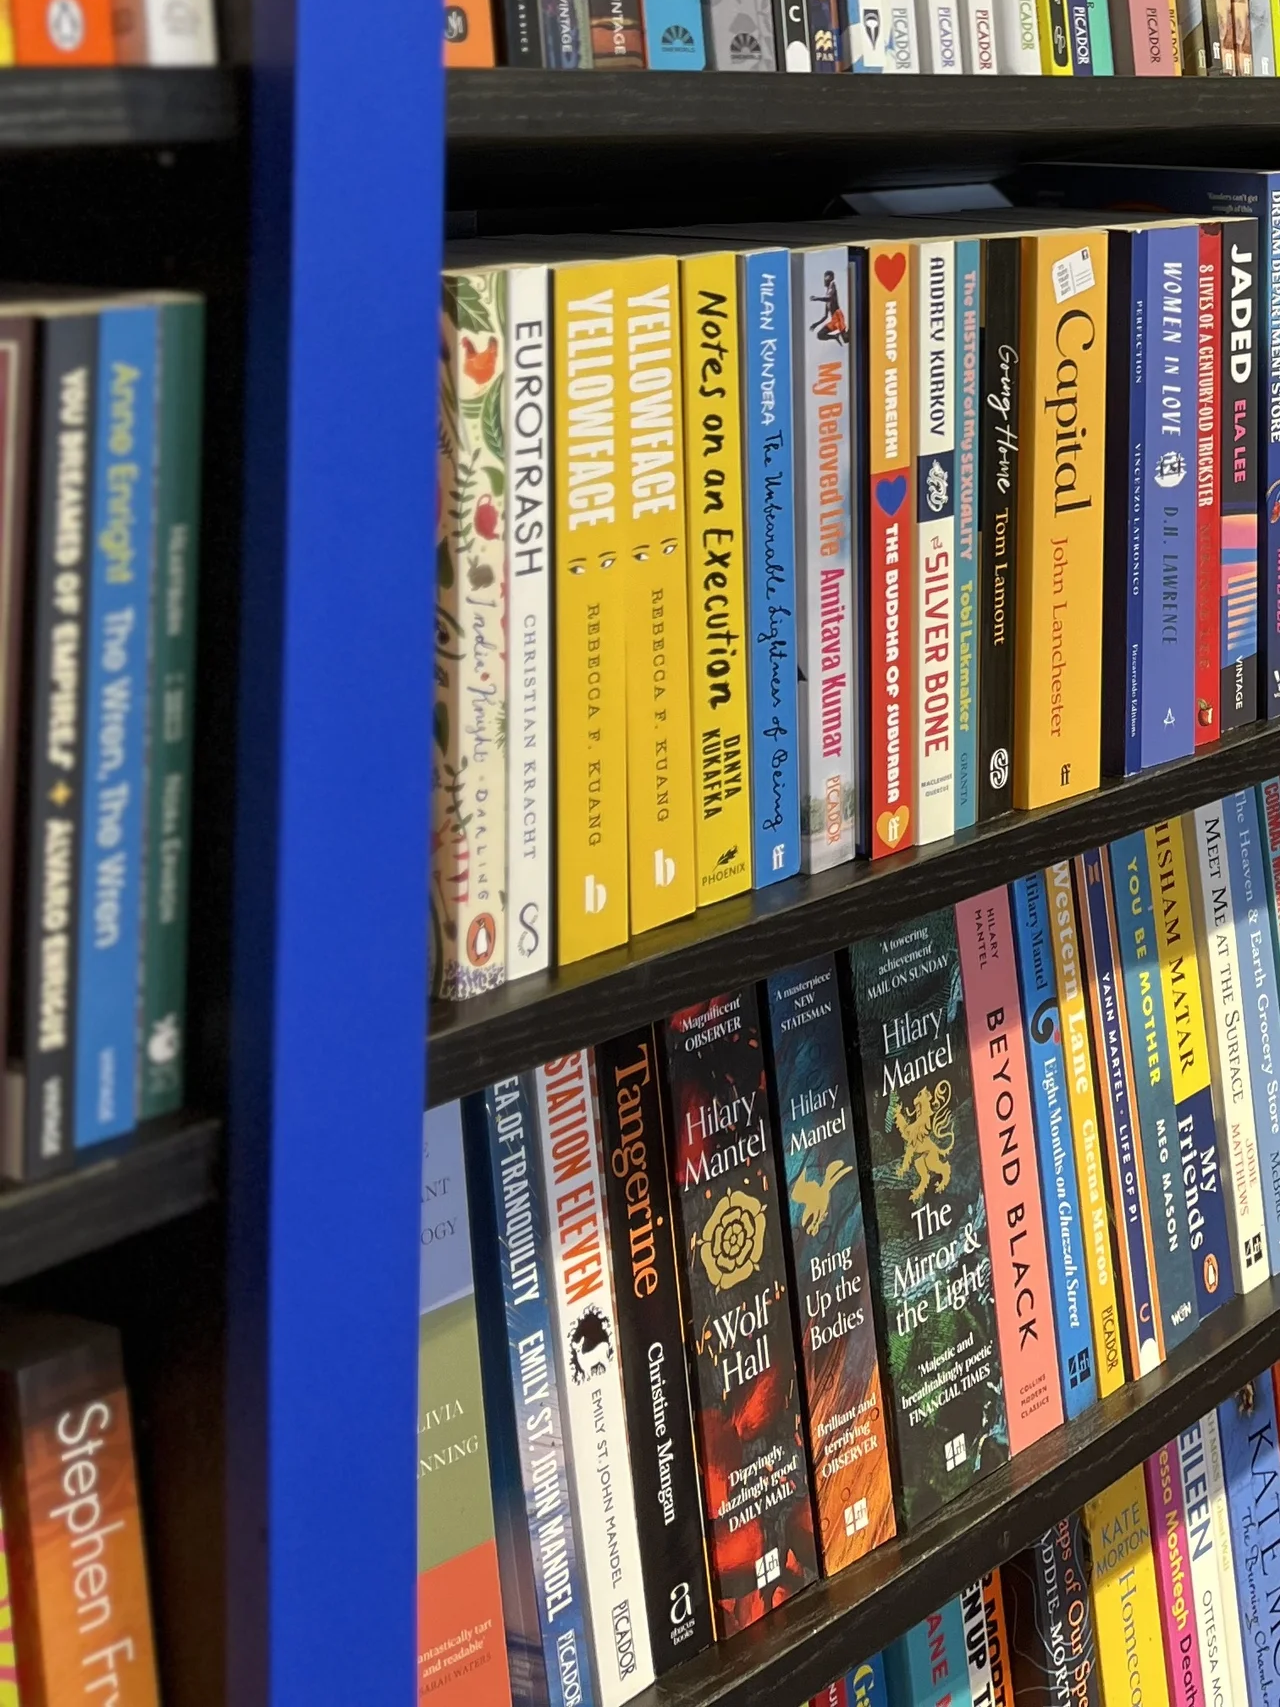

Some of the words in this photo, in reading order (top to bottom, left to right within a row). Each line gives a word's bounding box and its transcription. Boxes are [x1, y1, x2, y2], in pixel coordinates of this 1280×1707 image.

[1073, 6, 1088, 64] PICADOR
[760, 272, 775, 331] MILAN
[1162, 261, 1183, 344] WOMEN
[1230, 243, 1253, 384] JADED
[697, 290, 729, 399] Notes
[760, 338, 777, 426] KUNDERA
[1164, 356, 1180, 376] IN
[110, 364, 140, 452] Anne
[568, 289, 614, 531] YELLOWFACE
[627, 284, 676, 519] YELLOWFACE
[929, 350, 945, 437] KURKOV
[1044, 309, 1096, 518] Capital
[1161, 384, 1182, 437] LOVE
[1233, 400, 1247, 442] ELA
[514, 321, 543, 578] EUROTRASH
[703, 414, 726, 457] on
[1234, 445, 1247, 484] LEE
[703, 469, 726, 514] an
[885, 523, 899, 565] THE
[1050, 537, 1070, 595] John
[703, 528, 741, 710] Execution
[885, 568, 899, 662] BUDDHA
[925, 552, 948, 664] SILVER
[523, 614, 537, 749] CHRISTIAN
[886, 665, 900, 698] OF
[1050, 601, 1067, 738] Lanchester
[886, 703, 900, 803] SUBURBIA
[925, 671, 948, 756] BONE
[702, 728, 722, 821] KUKAFKA
[723, 735, 743, 801] DANYA
[523, 760, 537, 859] KRACHT
[702, 862, 746, 885] PHOENIX
[1126, 856, 1141, 915] YOU
[1135, 927, 1147, 959] BE
[882, 1008, 943, 1056] Hilary
[1138, 972, 1161, 1087] MOTHER
[1168, 956, 1195, 1076] MATAR
[882, 1033, 953, 1097] Mantel
[683, 1119, 767, 1191] Mantel
[685, 1091, 757, 1146] Hilary
[613, 1043, 664, 1299] Tangerine
[986, 1007, 1020, 1185] BEYOND
[1007, 1202, 1038, 1352] BLACK
[1178, 1114, 1205, 1251] Friends
[1199, 1145, 1217, 1195] My
[500, 1146, 539, 1305] TRANQUILITY
[556, 1180, 603, 1305] ELEVEN
[894, 1239, 960, 1300] Mirror
[962, 1222, 982, 1254] &
[911, 1203, 952, 1243] The
[806, 1289, 832, 1318] Up
[834, 1269, 862, 1304] the
[810, 1247, 853, 1282] Bring
[896, 1299, 929, 1338] the
[933, 1264, 986, 1314] Light
[714, 1288, 771, 1350] Wolf
[811, 1309, 865, 1351] Bodies
[519, 1330, 549, 1409] EMILY
[647, 1343, 670, 1438] Christine
[723, 1335, 772, 1394] Hall
[50, 1400, 125, 1634] Stephen
[531, 1450, 559, 1518] JOHN
[657, 1439, 674, 1525] Mangan
[540, 1516, 573, 1623] MANDEL
[612, 1602, 634, 1679] PICADOR
